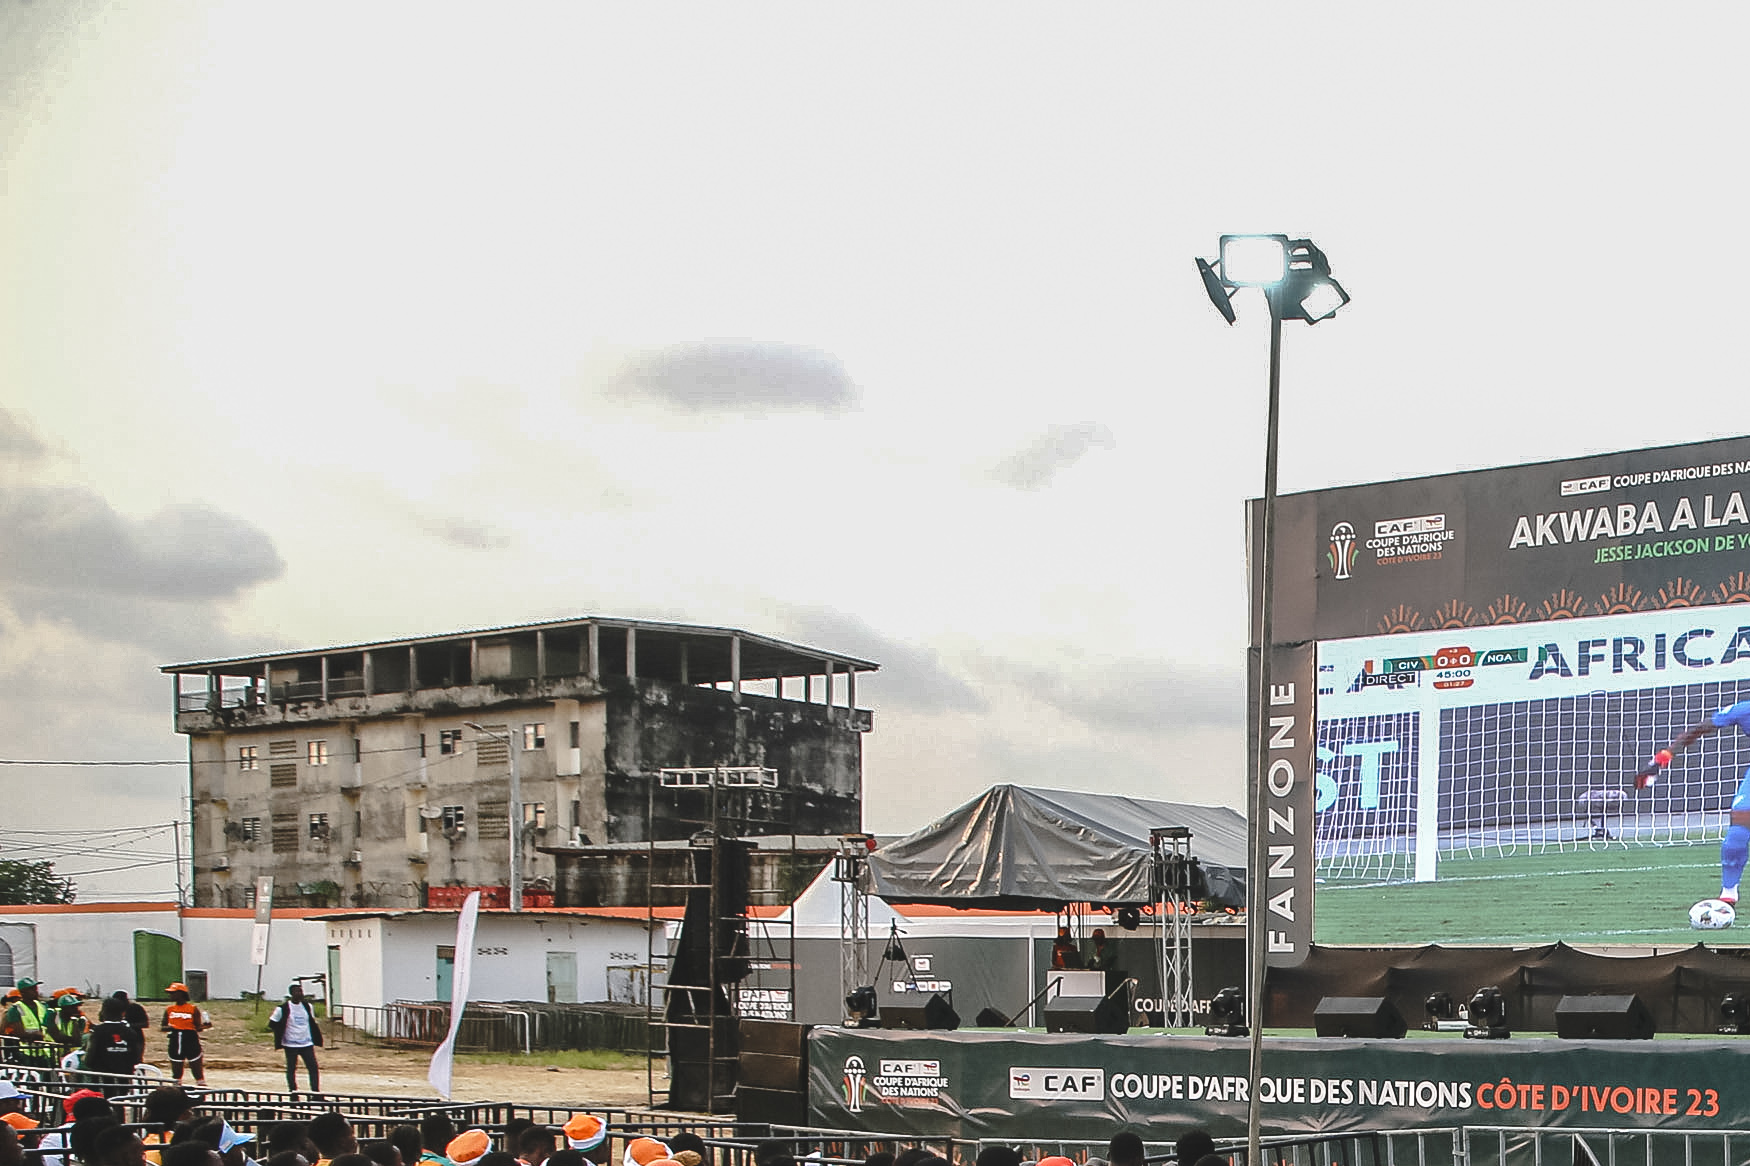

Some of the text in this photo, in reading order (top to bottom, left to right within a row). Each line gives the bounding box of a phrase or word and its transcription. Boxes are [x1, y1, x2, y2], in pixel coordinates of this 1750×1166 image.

[1579, 479, 1606, 491] CAF
[1613, 472, 1651, 488] COUPE
[1652, 466, 1711, 483] D'AFRIQUE
[1712, 464, 1734, 477] DES
[1508, 501, 1664, 549] AKWABA
[1668, 496, 1698, 532] A
[1703, 491, 1750, 528] LA
[1377, 522, 1413, 535] CAF
[1366, 530, 1455, 549] COUPE D'AFRIQUE
[1376, 542, 1443, 558] DES NATIONS
[1593, 545, 1632, 564] JESSE
[1634, 538, 1710, 561] JACKSON
[1714, 535, 1736, 551] DE
[1398, 660, 1420, 670] CIV
[1487, 654, 1513, 664] NGA
[1366, 673, 1415, 686] DIRECT
[1436, 669, 1471, 679] 45:00
[1267, 681, 1296, 955] FANZONE
[883, 1063, 913, 1073] CAF
[873, 1076, 949, 1088] COUPE D'AFRIQUE
[882, 1086, 939, 1097] DES NATIONS
[1044, 1073, 1720, 1118] CAF COUPE D'AFRQUE DES NATIONS CÔTE D'IVOIRE 23
